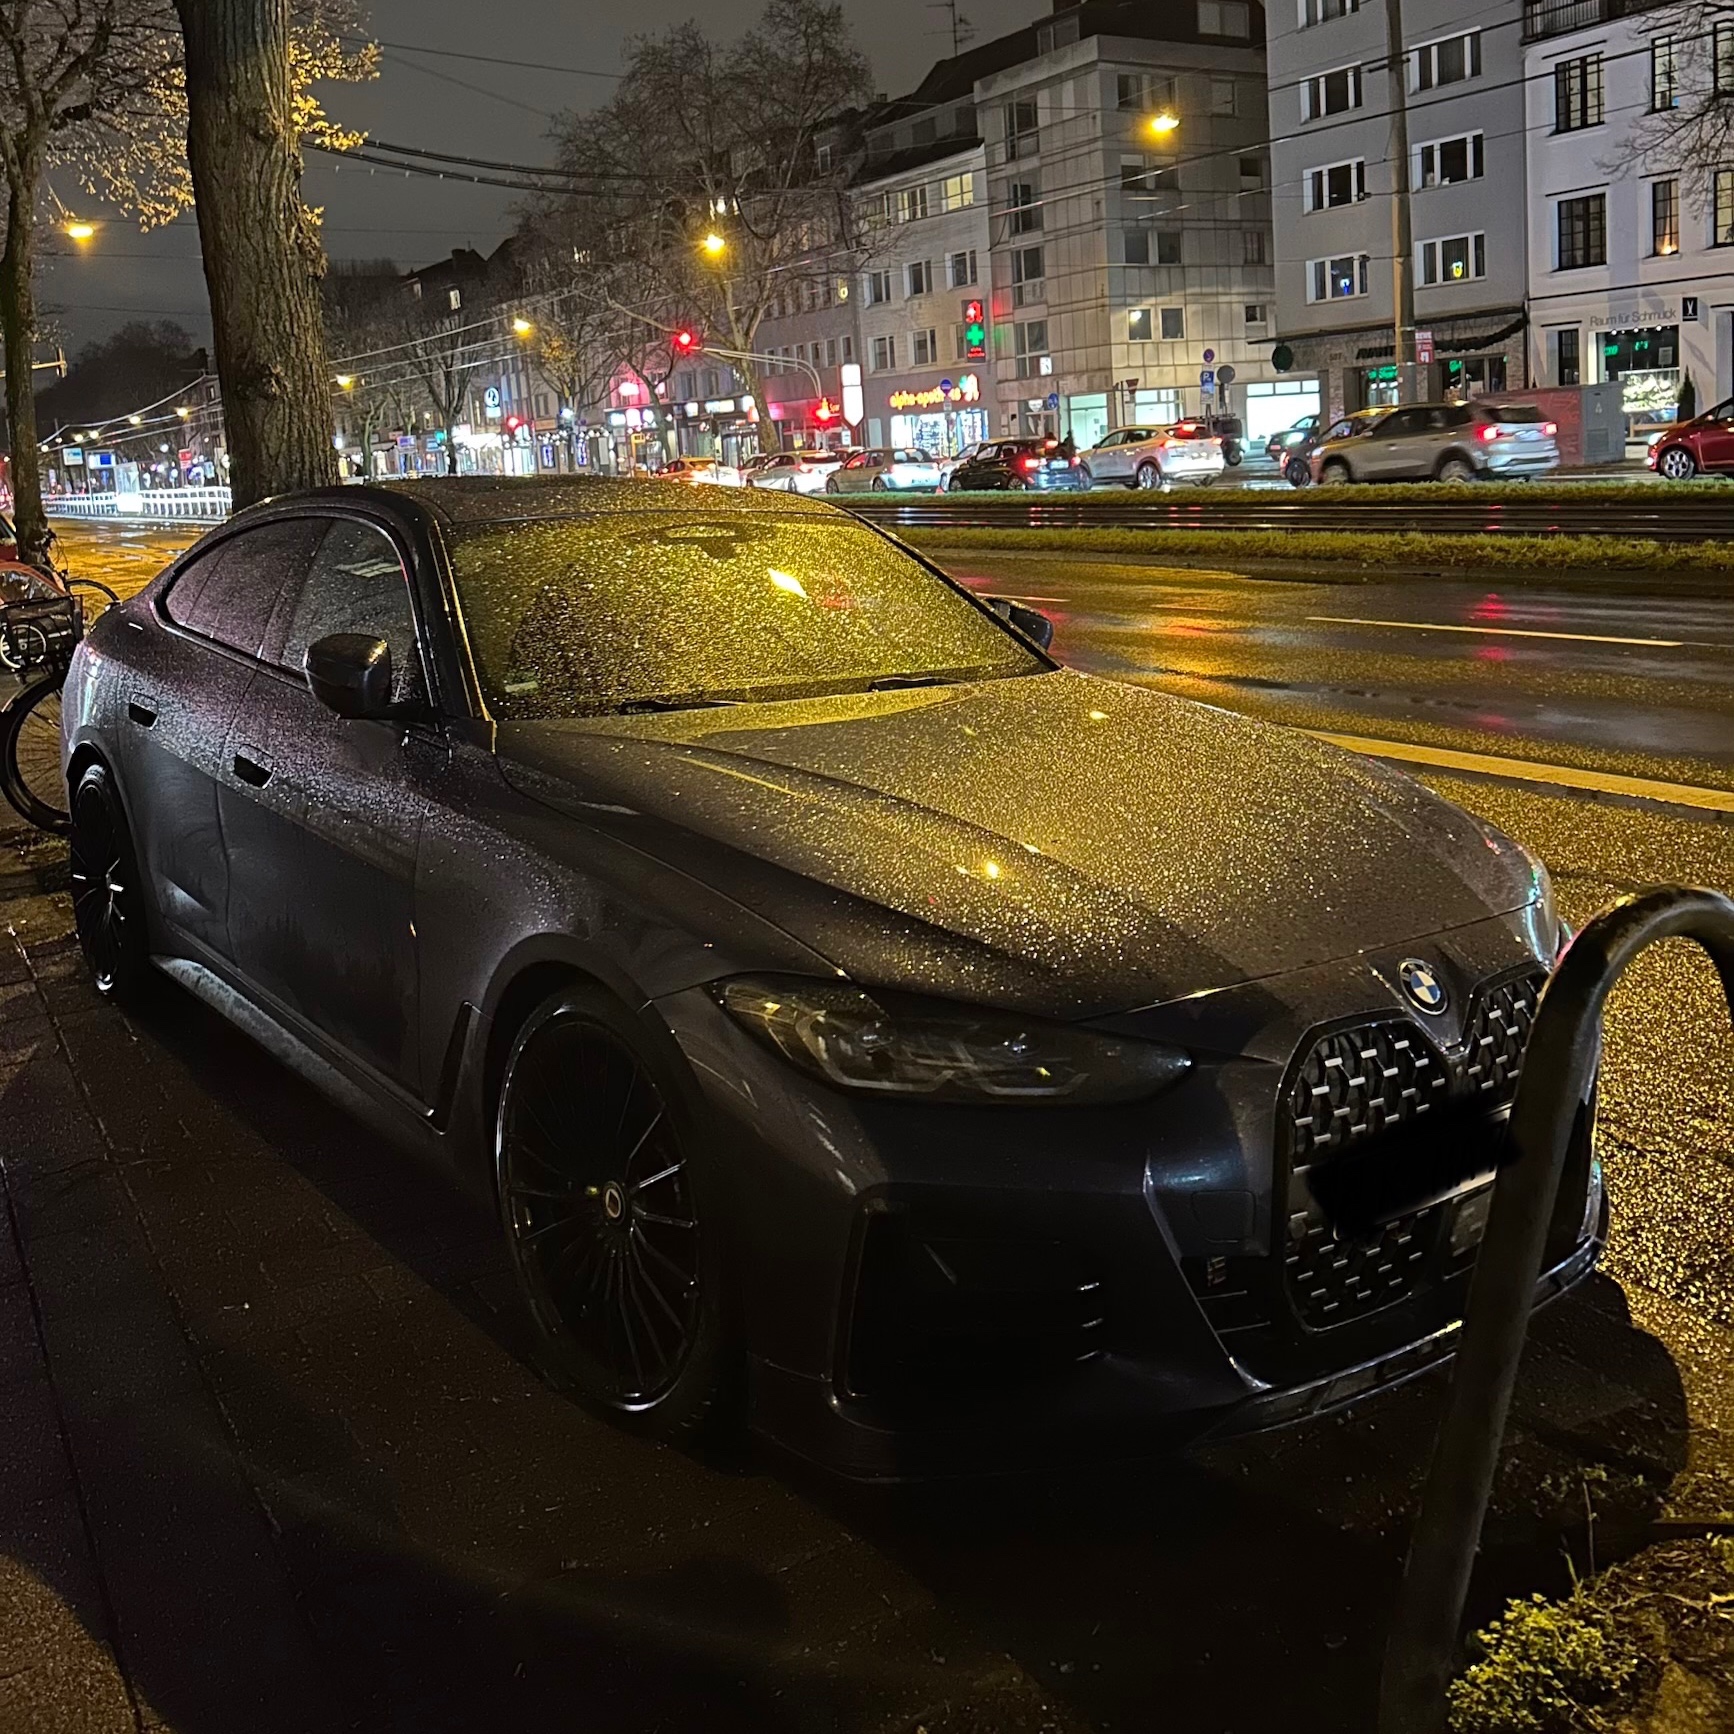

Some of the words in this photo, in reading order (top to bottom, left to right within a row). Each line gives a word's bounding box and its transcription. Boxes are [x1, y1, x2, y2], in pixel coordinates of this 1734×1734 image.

[1590, 315, 1617, 326] Raum
[1618, 313, 1630, 324] für
[1632, 308, 1676, 323] Schmuck
